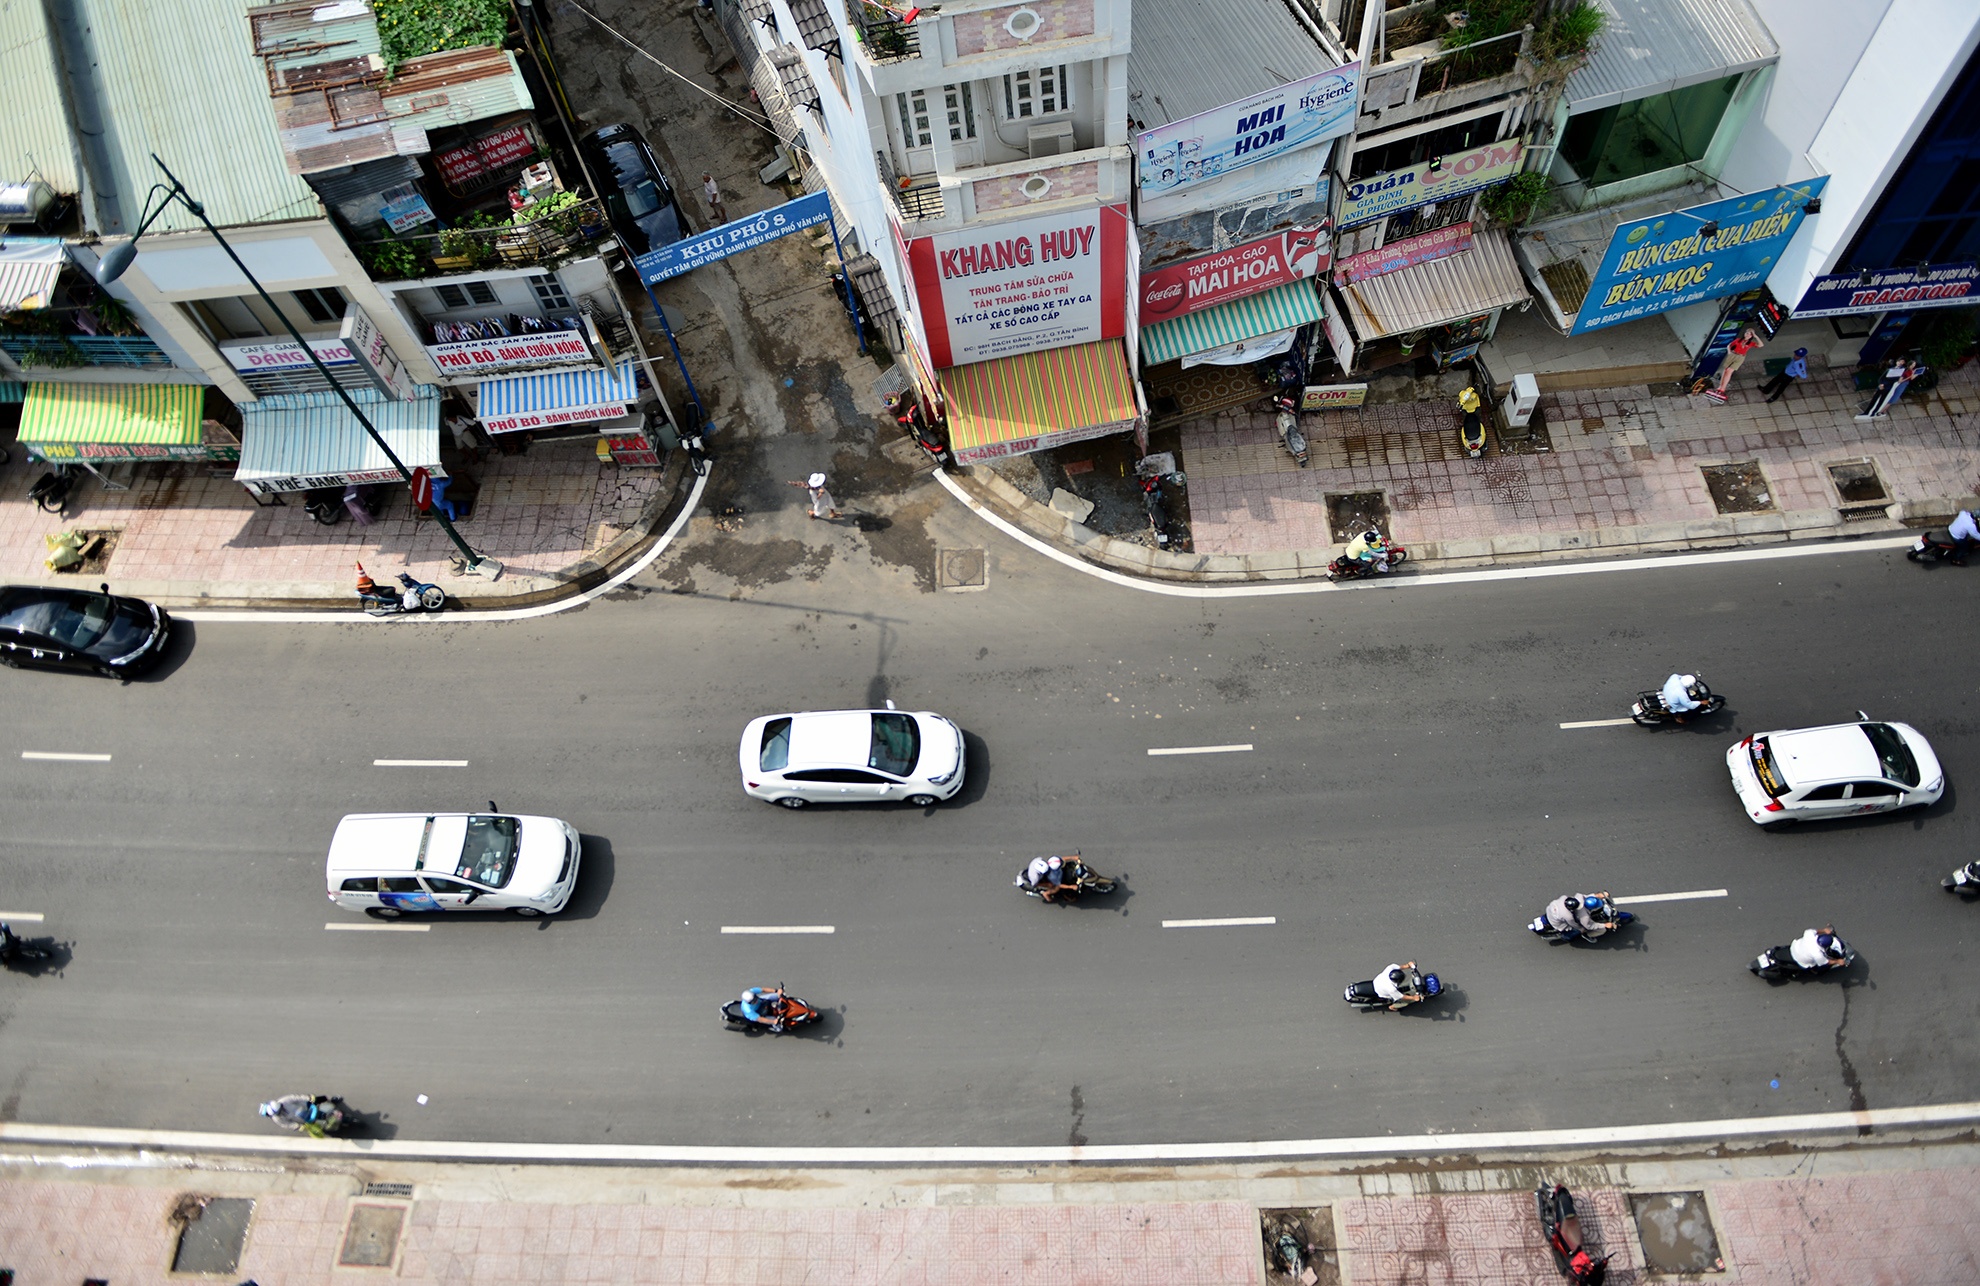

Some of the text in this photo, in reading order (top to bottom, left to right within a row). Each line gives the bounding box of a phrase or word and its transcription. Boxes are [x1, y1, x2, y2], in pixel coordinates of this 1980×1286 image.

[1299, 82, 1354, 109] Hygiene
[1236, 104, 1286, 135] MAI
[1234, 124, 1286, 156] HOA
[1349, 171, 1416, 202] Quán
[1356, 189, 1404, 210] GIA ĐÌNH
[1342, 194, 1418, 223] ANH PHƯƠNG 2
[649, 212, 829, 283] QUYẾT TÂM GIỮ VỮNG DANH HIỆU KHU PHỐ VĂN HÓA
[680, 212, 786, 260] KHU PHỐ 8
[1613, 242, 1664, 278] BÚN
[1703, 223, 1745, 254] CUA
[1742, 200, 1797, 244] BIỂN
[940, 225, 1096, 280] KHANG HUY
[1187, 262, 1209, 277] TẠP
[1210, 254, 1236, 270] HÓA
[1242, 245, 1268, 262] GẠO
[1382, 257, 1410, 273] 20%
[968, 270, 1074, 297] TRUNG TÂM SỬA CHỮA
[1188, 254, 1280, 298] MAI HOA
[1600, 262, 1714, 309] BÚN MỌC
[1816, 278, 1837, 292] CÔNG
[1836, 278, 1850, 290] TY
[1880, 272, 1914, 286] THƯƠNG
[1928, 272, 1941, 282] DU
[1939, 268, 1960, 282] LỊCH
[1958, 266, 1970, 280] VÀ
[974, 284, 1069, 309] TÂN TRANG BẢO TRÌ
[1600, 310, 1624, 326] BẠCH
[1622, 304, 1645, 320] ĐẰNG,
[1645, 300, 1660, 314] P.2,
[1670, 294, 1687, 307] TÂN
[1686, 289, 1706, 304] BÌNH
[1849, 282, 1972, 306] TRACOTOUR
[954, 313, 974, 326] TẤT
[976, 310, 990, 322] CẢ
[991, 306, 1011, 320] CÁC
[1042, 300, 1054, 311] XE
[1058, 296, 1077, 308] TAY
[1078, 294, 1092, 304] GA
[989, 310, 1060, 331] XE SỐ CAO CẤP
[522, 334, 544, 342] NAM
[990, 340, 1012, 348] BẠCH
[1013, 334, 1035, 345] ĐẰNG,
[1072, 326, 1090, 334] BÌNH
[436, 350, 472, 368] PHỞ
[471, 347, 496, 364] BÒ
[500, 345, 528, 362] BÁNH
[528, 340, 556, 358] CUỐN
[556, 338, 586, 355] NÓNG
[1306, 390, 1348, 400] CƠM
[488, 405, 624, 432] PHỞ BÒ BÁNH CUỐN NÓNG
[42, 442, 76, 458] PHỞ
[608, 433, 649, 451] PHỞ
[958, 438, 1040, 462] KHANG HUY
[278, 476, 306, 491] PHÊ
[306, 474, 349, 489] GAME
